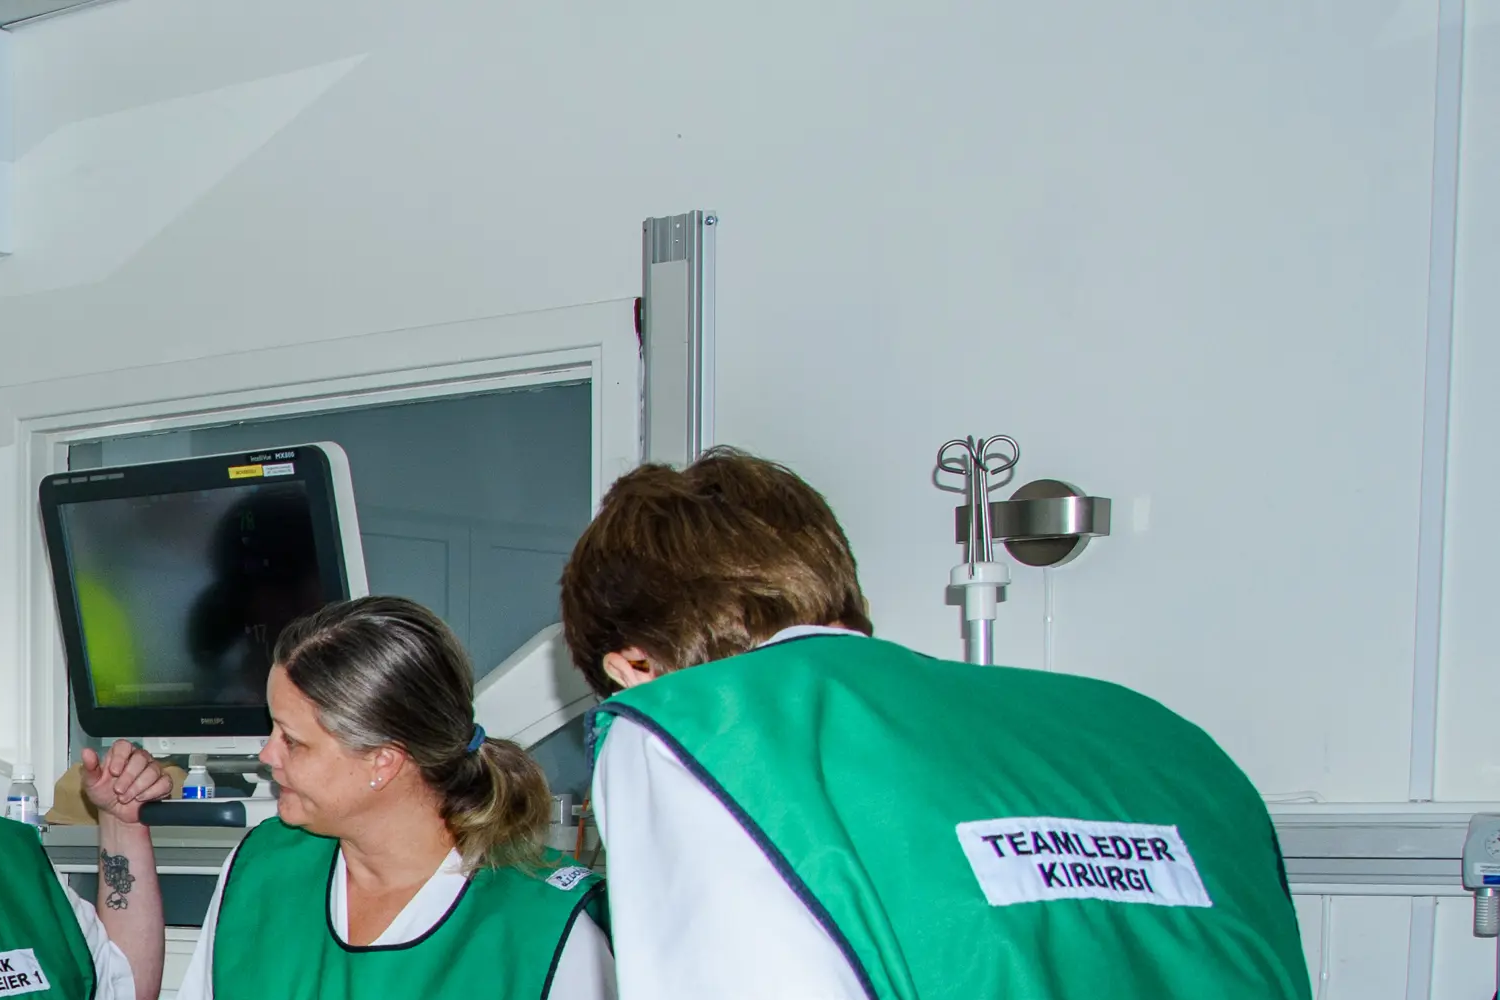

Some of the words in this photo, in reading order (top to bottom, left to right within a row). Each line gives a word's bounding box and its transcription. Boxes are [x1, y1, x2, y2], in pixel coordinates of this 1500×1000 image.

[275, 451, 295, 459] MX800
[981, 830, 1176, 862] TEAMLEDER
[1037, 862, 1155, 893] KIRURGI
[32, 970, 43, 984] 1
